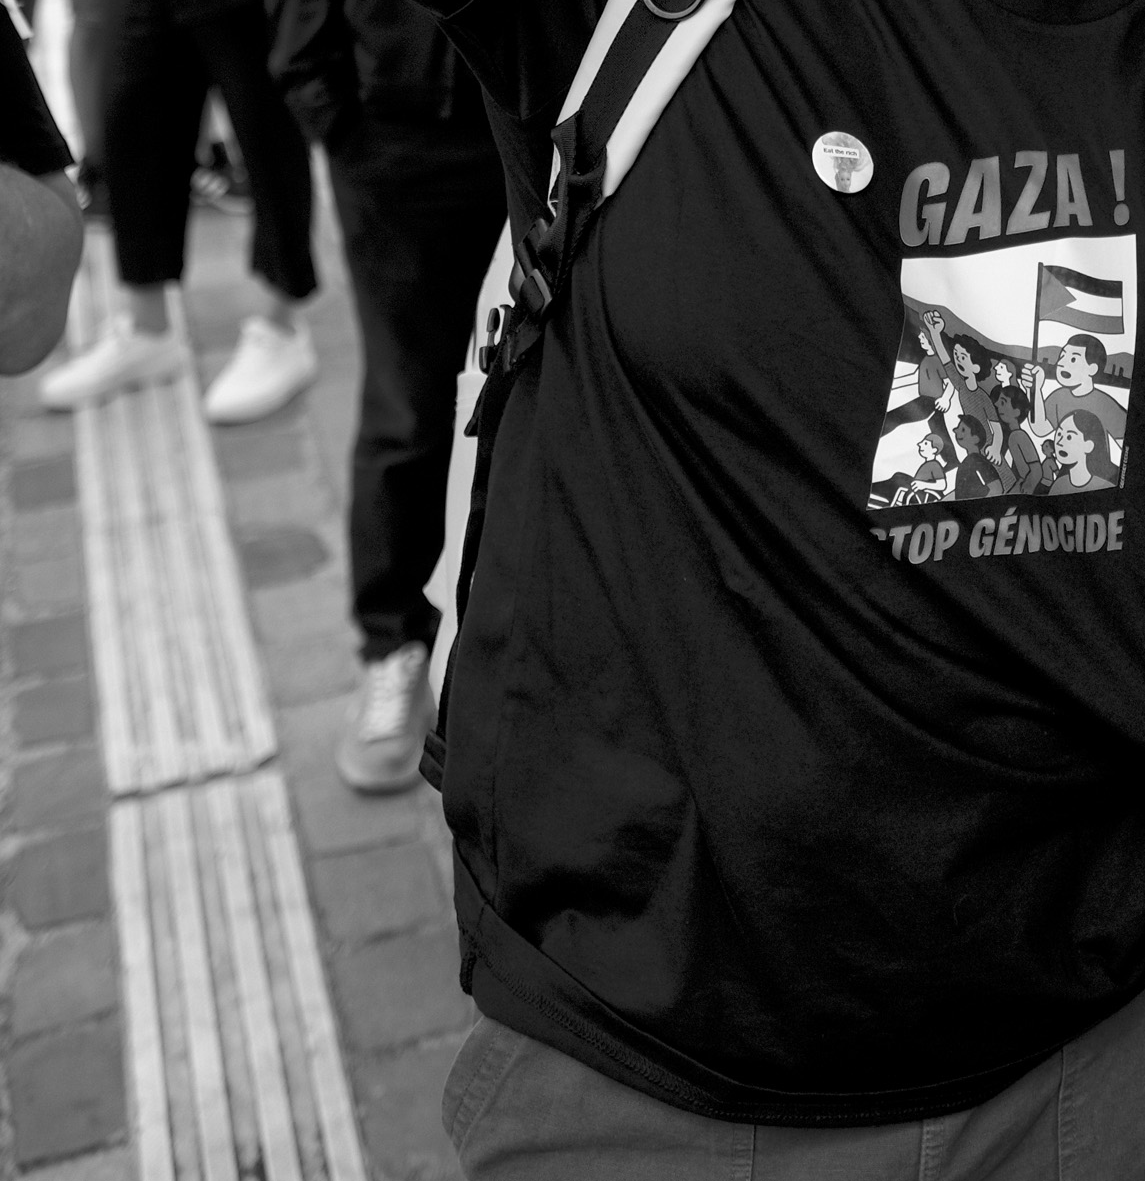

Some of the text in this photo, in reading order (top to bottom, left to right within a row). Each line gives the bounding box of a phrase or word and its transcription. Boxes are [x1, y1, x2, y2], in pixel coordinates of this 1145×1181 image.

[899, 149, 1130, 247] GAZA !
[869, 506, 1125, 565] TOP GÉNOCIDE
